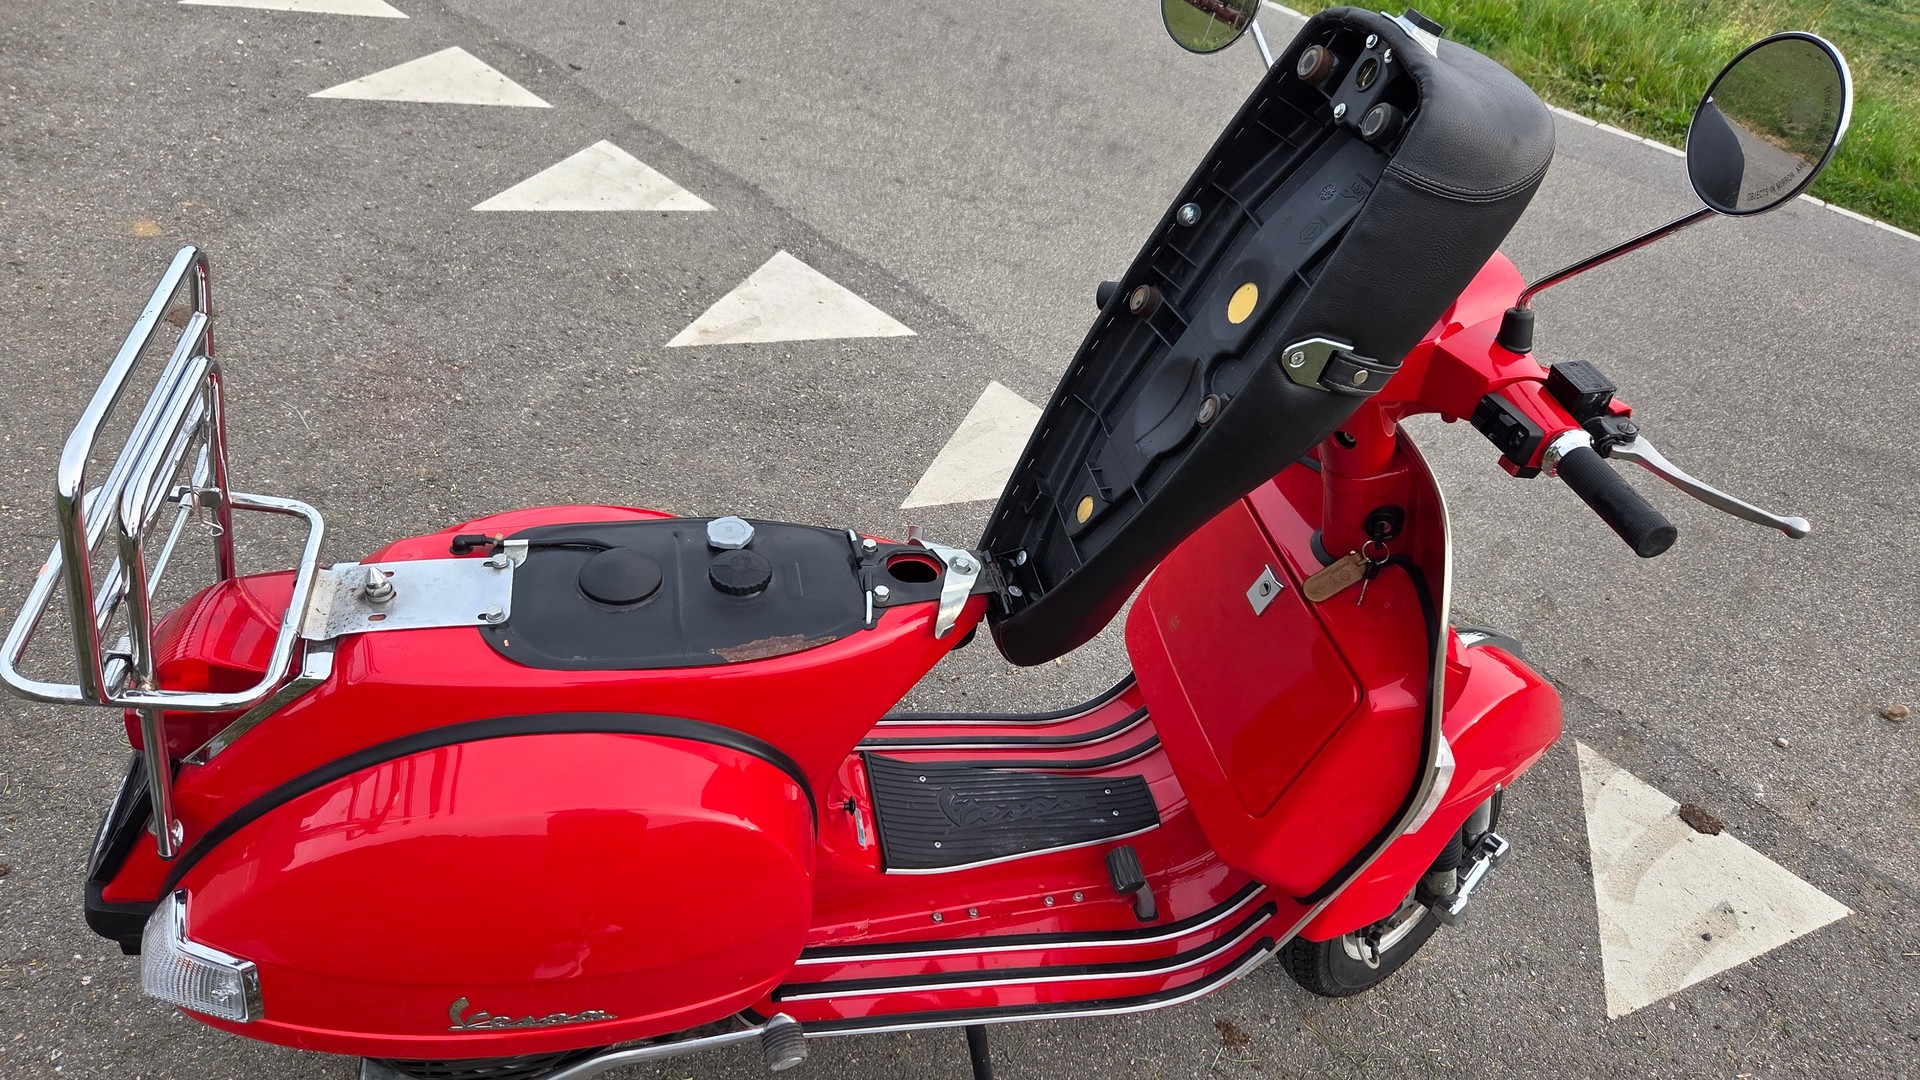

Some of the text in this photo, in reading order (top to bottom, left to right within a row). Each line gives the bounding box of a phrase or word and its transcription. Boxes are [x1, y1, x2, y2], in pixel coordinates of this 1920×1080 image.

[1747, 187, 1769, 201] OBJECTS
[1776, 172, 1795, 189] MIRROR
[1796, 161, 1806, 173] ARE
[447, 997, 616, 1031] Vespa
